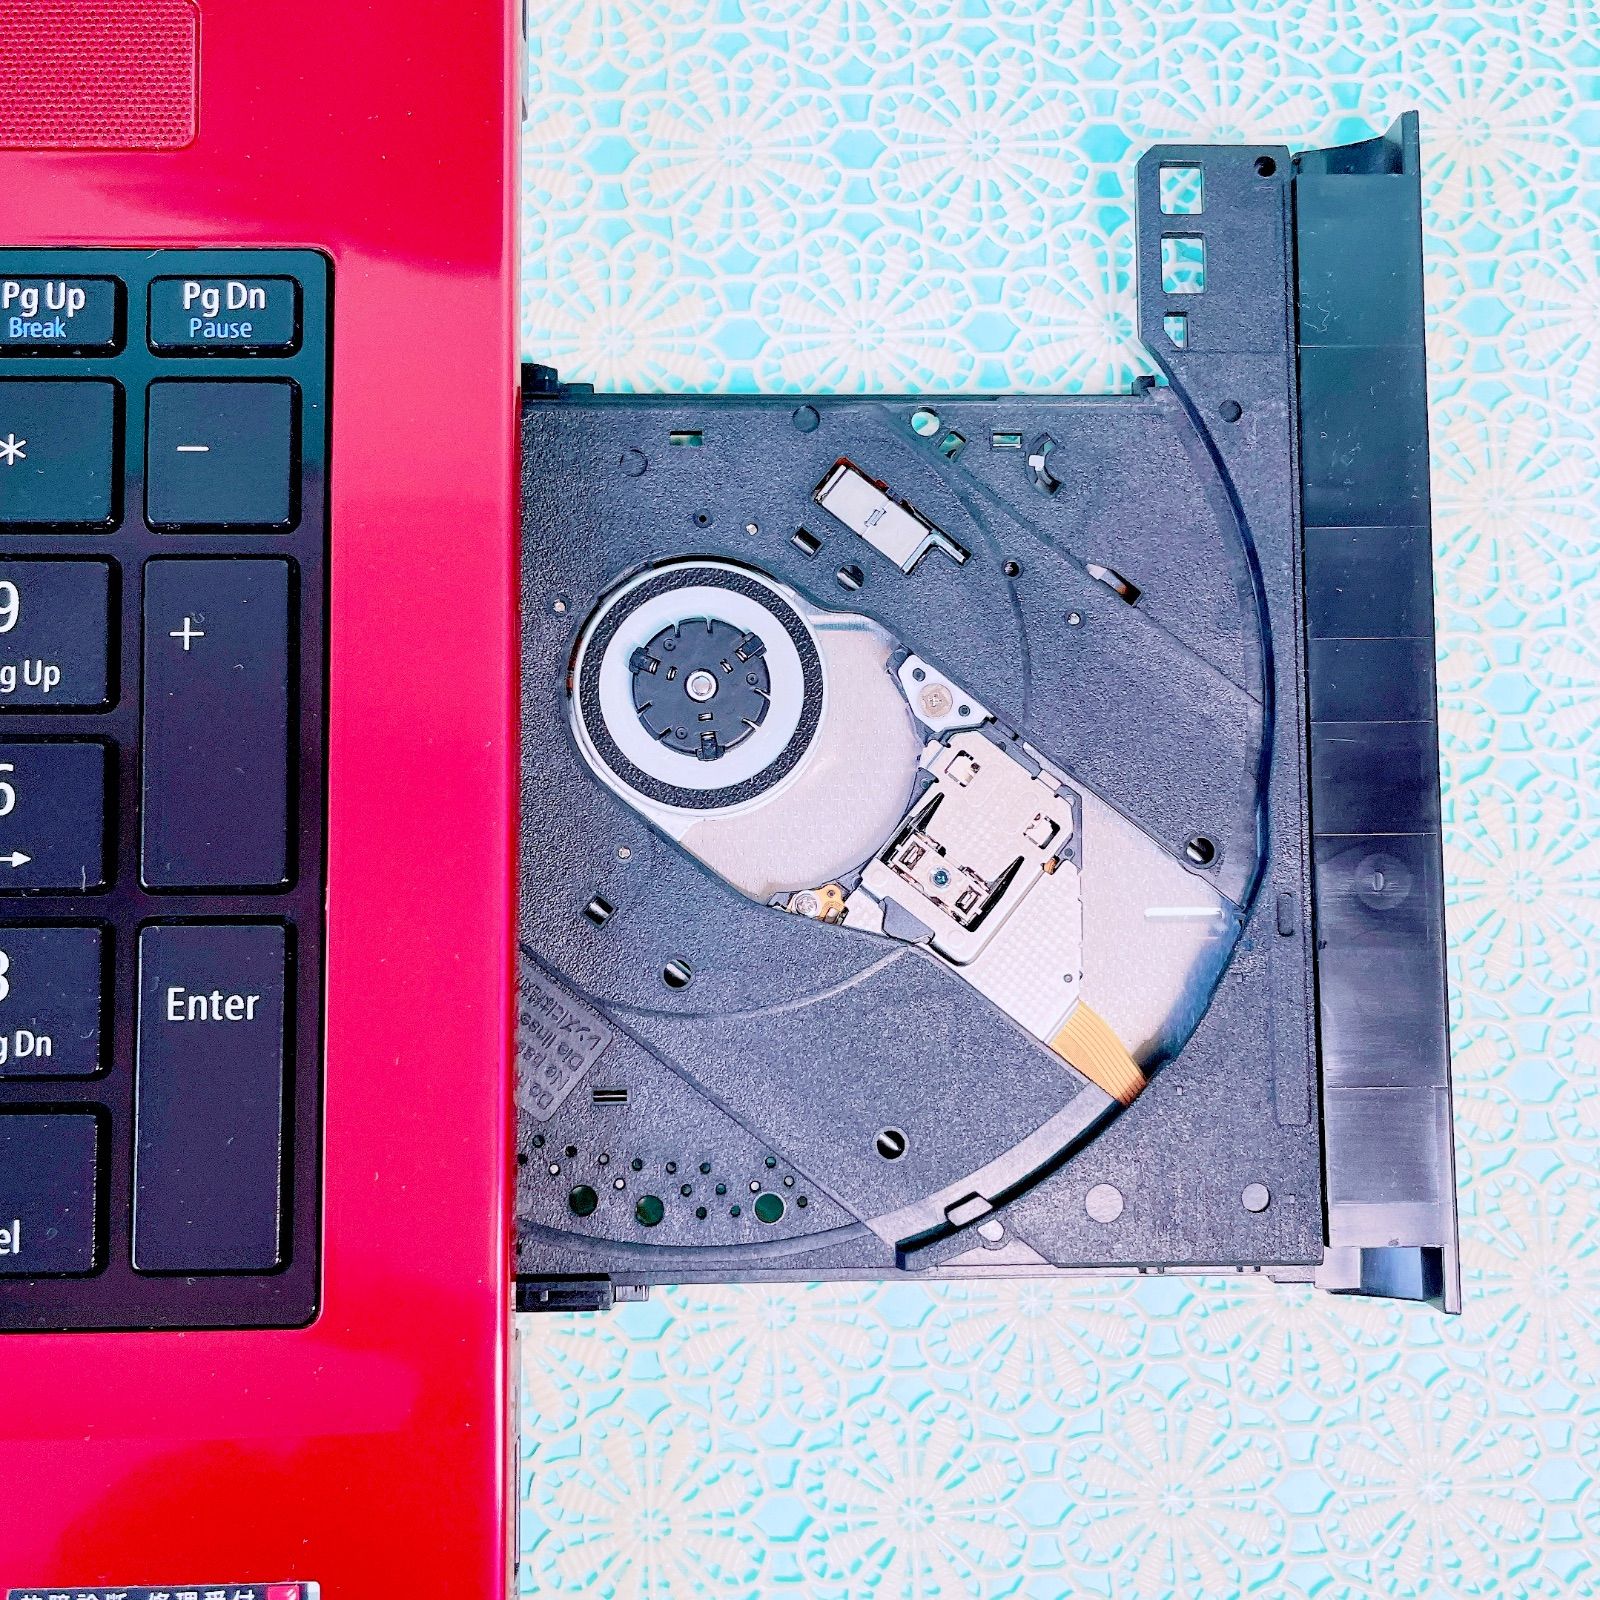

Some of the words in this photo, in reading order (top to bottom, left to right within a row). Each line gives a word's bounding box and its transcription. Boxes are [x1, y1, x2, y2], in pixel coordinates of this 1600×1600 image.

[2, 281, 39, 317] Pg
[46, 282, 86, 317] Up
[183, 282, 220, 317] Pg
[227, 282, 266, 310] Dn
[9, 316, 67, 338] Break
[190, 317, 253, 339] Pause
[24, 659, 61, 693] Up
[166, 986, 260, 1021] Enter
[15, 1030, 52, 1057] Dn
[0, 1219, 20, 1254] el
